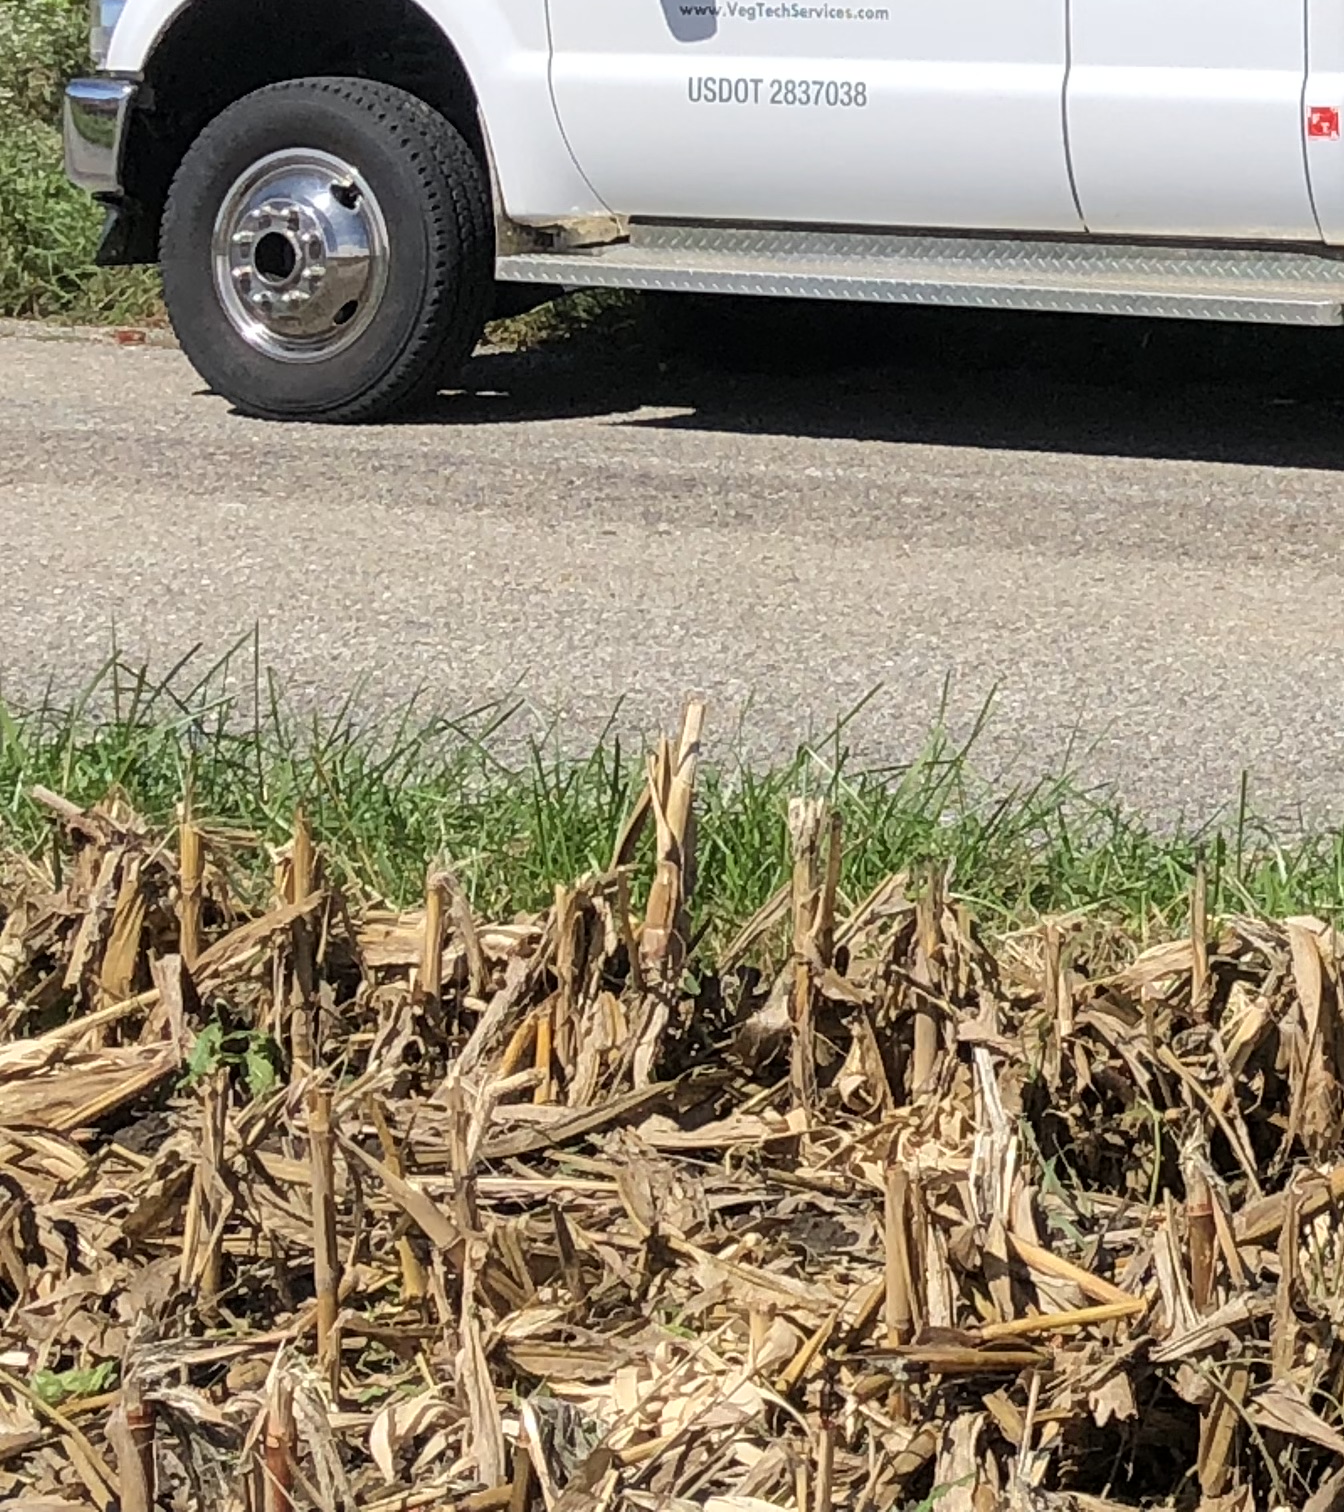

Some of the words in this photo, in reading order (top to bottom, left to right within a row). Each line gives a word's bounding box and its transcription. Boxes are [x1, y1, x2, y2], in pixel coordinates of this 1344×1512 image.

[679, 1, 890, 21] www.VegTechServices.com
[688, 76, 764, 105] USDOT
[769, 78, 867, 107] 2837038
